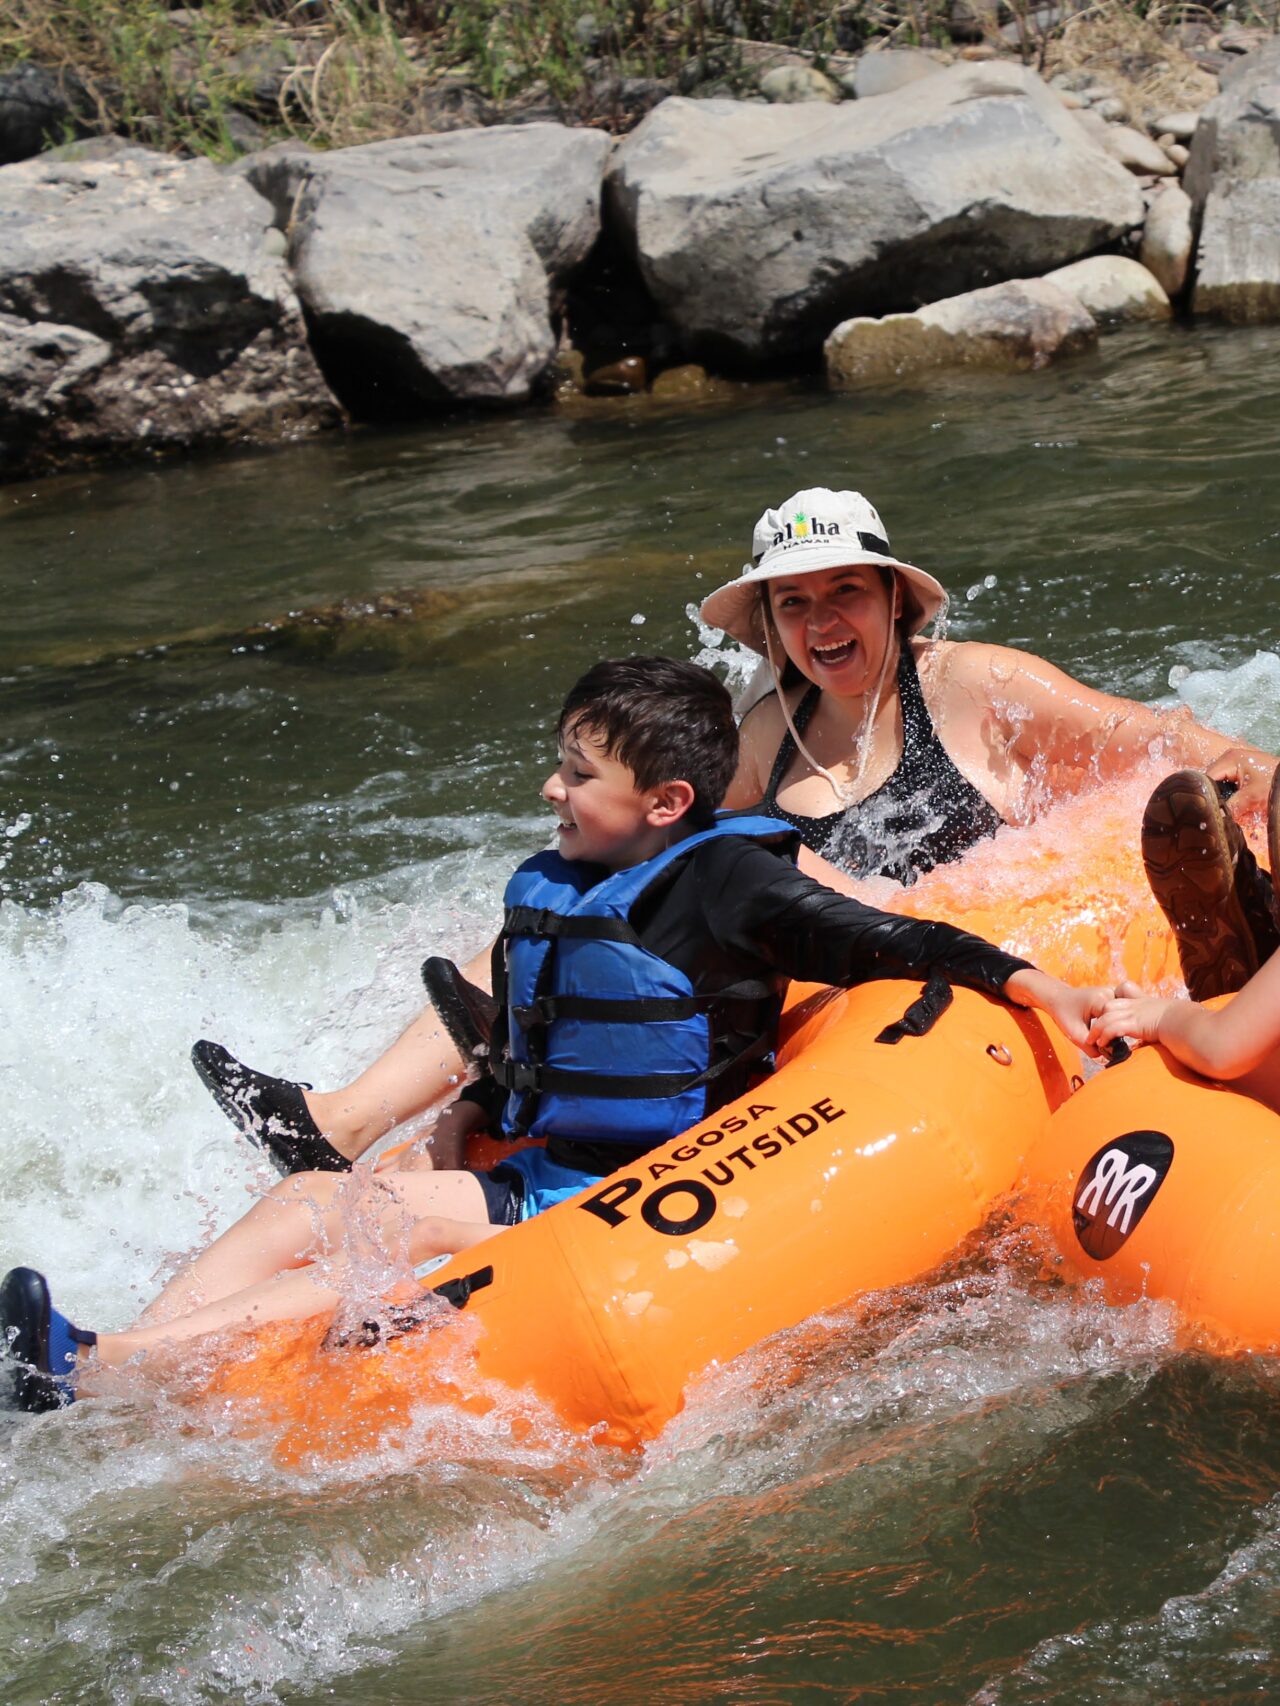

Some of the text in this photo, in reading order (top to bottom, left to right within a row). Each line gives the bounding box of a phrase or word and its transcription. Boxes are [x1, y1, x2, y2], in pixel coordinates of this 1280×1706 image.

[773, 513, 840, 546] aloha
[577, 1103, 778, 1229] PAGOSA
[641, 1097, 847, 1236] OUTSIDE
